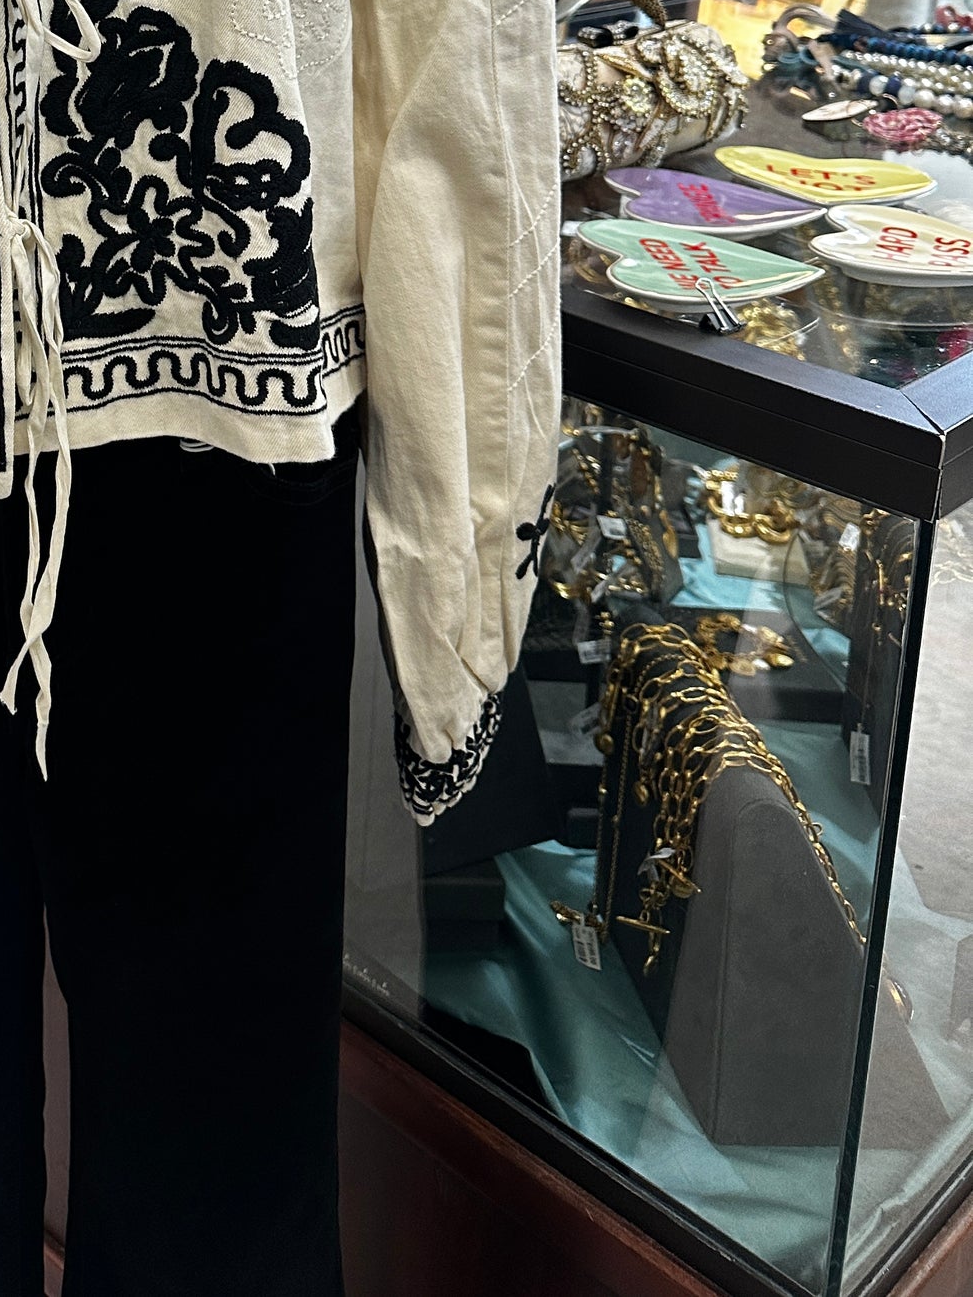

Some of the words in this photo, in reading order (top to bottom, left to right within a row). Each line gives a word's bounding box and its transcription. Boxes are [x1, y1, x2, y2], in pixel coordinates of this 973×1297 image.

[766, 164, 876, 185] LET'S
[639, 238, 692, 271] NEED
[678, 241, 732, 274] TALK
[871, 226, 918, 264] HARD
[928, 236, 972, 268] PASS
